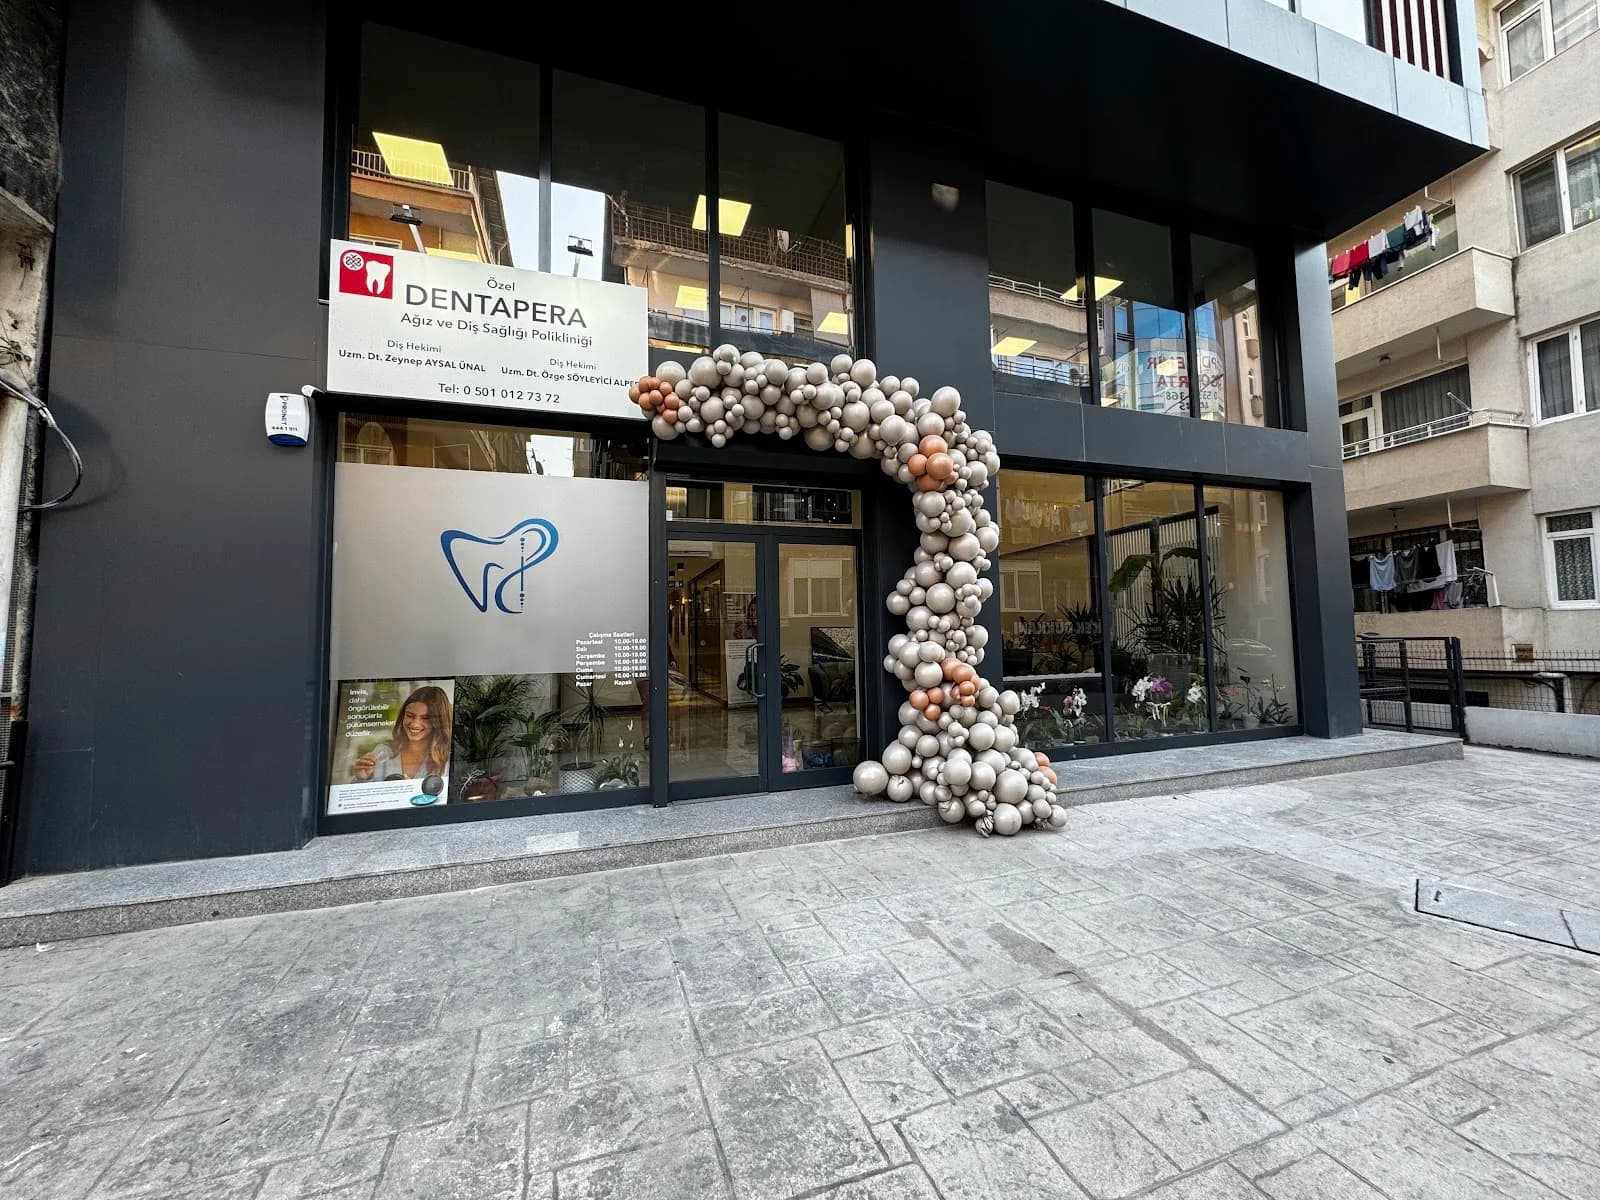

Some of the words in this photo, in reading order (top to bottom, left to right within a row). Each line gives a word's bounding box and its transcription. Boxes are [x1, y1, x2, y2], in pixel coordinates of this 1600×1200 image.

[487, 276, 515, 292] Özel
[406, 283, 587, 329] DENTAPERA
[401, 312, 433, 327] Ağız
[437, 320, 453, 329] ve
[457, 319, 479, 334] Diş
[483, 322, 528, 340] Sağlığı
[532, 329, 593, 348] Polikliniği
[387, 339, 404, 351] Diş
[406, 341, 442, 353] Hekimi
[338, 349, 365, 360] Uzm.
[367, 352, 382, 361] Dt.
[385, 353, 423, 367] Zeynep
[424, 358, 457, 369] AYSAL
[459, 360, 486, 372] ÜNAL
[549, 358, 564, 369] Diş
[566, 359, 597, 371] Hekimi
[501, 367, 525, 377] Uzm.
[526, 369, 540, 378] Dt.
[541, 370, 565, 382] Özge
[567, 372, 612, 385] SÖYLEYİCİ
[613, 379, 640, 387] ALPE
[438, 382, 460, 394] Tel:
[463, 385, 471, 395] 0
[474, 386, 496, 398] 501
[500, 389, 523, 400] 012
[527, 391, 542, 402] 73
[545, 393, 560, 403] 72
